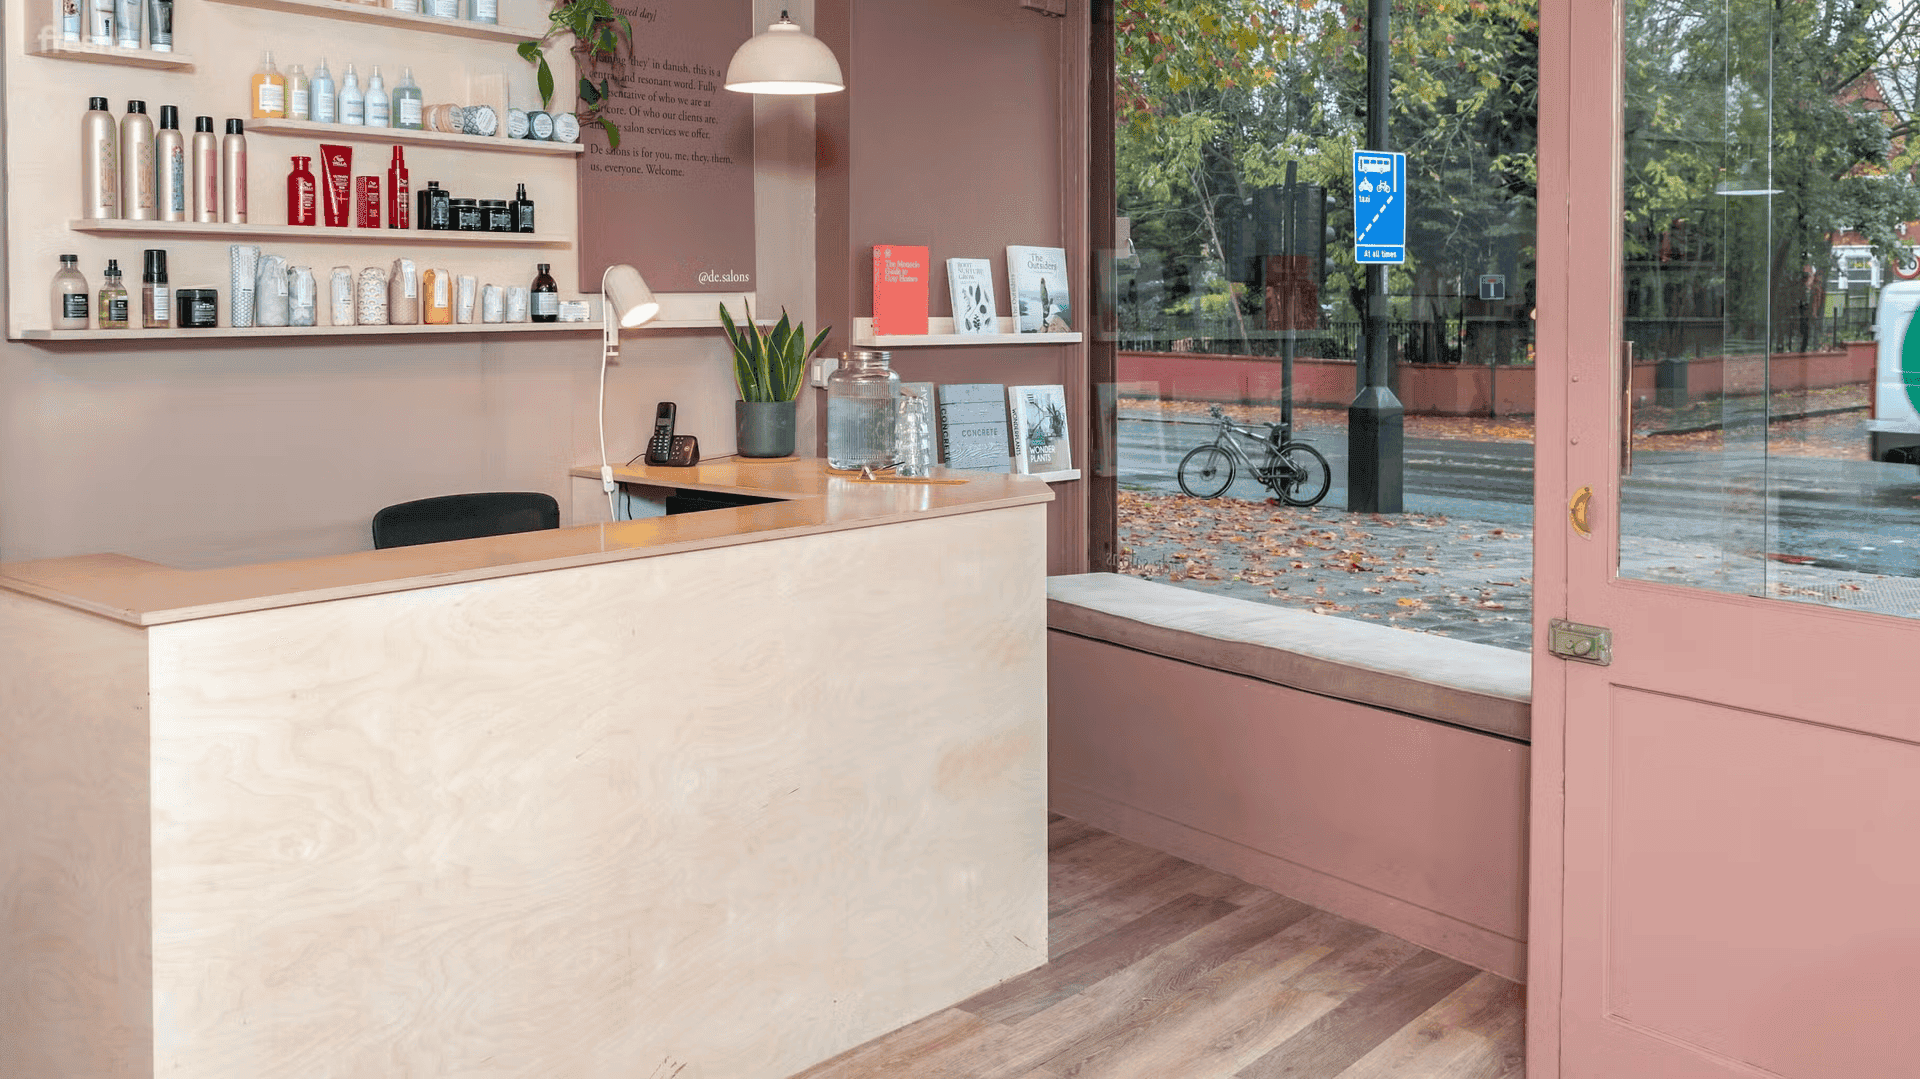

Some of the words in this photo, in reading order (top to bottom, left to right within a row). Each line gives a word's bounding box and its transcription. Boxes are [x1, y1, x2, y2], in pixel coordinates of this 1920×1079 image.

[652, 58, 660, 69] in
[693, 63, 707, 75] this
[709, 65, 716, 76] is
[638, 76, 671, 88] resonant
[674, 78, 696, 91] word.
[698, 81, 717, 95] Fully
[648, 91, 658, 103] of
[662, 93, 676, 104] who
[678, 97, 689, 105] we
[690, 98, 702, 107] are
[704, 99, 711, 108] at
[629, 105, 641, 116] Of
[643, 108, 660, 119] who
[662, 112, 676, 121] our
[678, 111, 703, 123] clients
[623, 122, 645, 134] salon
[646, 125, 677, 137] services
[678, 129, 689, 138] we
[691, 128, 711, 140] offer.
[590, 143, 603, 155] De
[605, 147, 630, 157] salons
[633, 147, 640, 158] is
[641, 146, 653, 159] for
[604, 164, 643, 176] everyone.
[646, 163, 685, 177] Welcome.
[1359, 195, 1370, 203] taxi
[1029, 253, 1043, 262] The
[1364, 250, 1371, 258] At
[1372, 250, 1380, 258] all
[1381, 250, 1397, 258] times
[1027, 260, 1057, 271] Outsiders
[698, 268, 750, 285] @de.salons
[941, 408, 950, 463] CONCRETE
[961, 428, 998, 437] CONCRETE
[1029, 444, 1056, 454] WONDER
[1030, 453, 1052, 463] PLANTS
